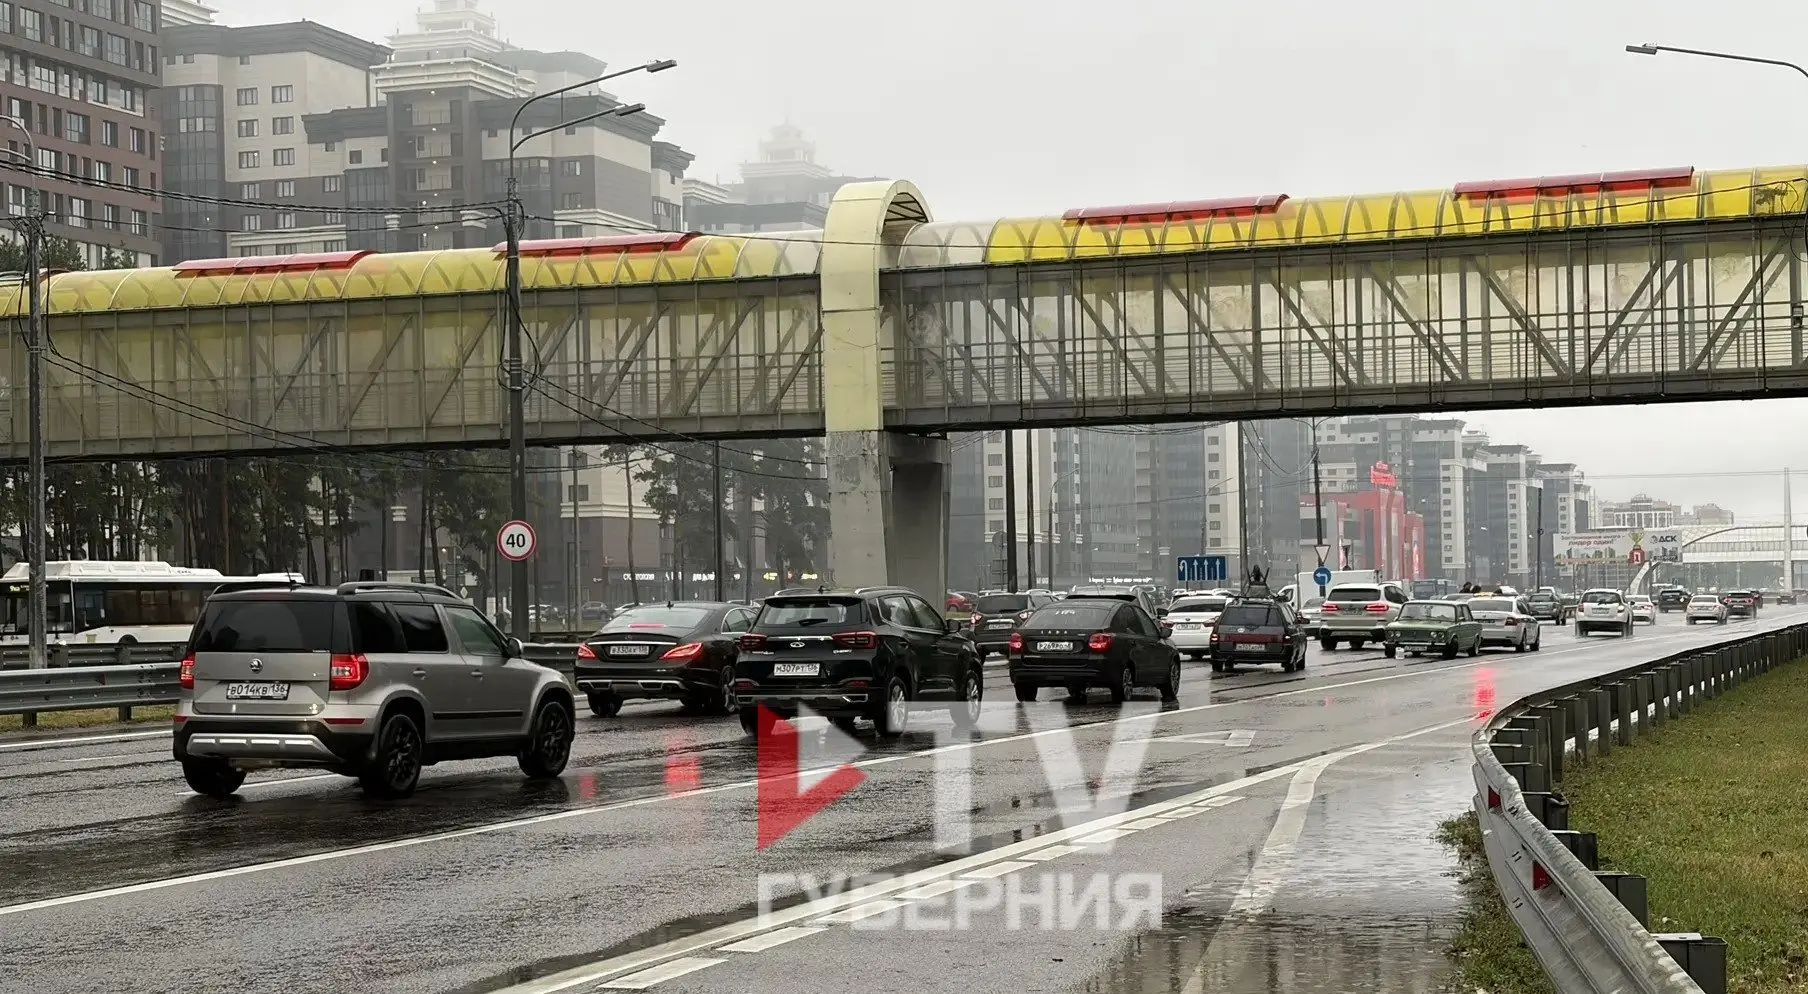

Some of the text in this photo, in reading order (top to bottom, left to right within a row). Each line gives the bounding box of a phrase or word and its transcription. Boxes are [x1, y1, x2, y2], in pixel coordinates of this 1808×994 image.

[506, 533, 526, 548] 40
[1658, 535, 1678, 543] ДСК
[230, 683, 286, 695] В014КВ 136
